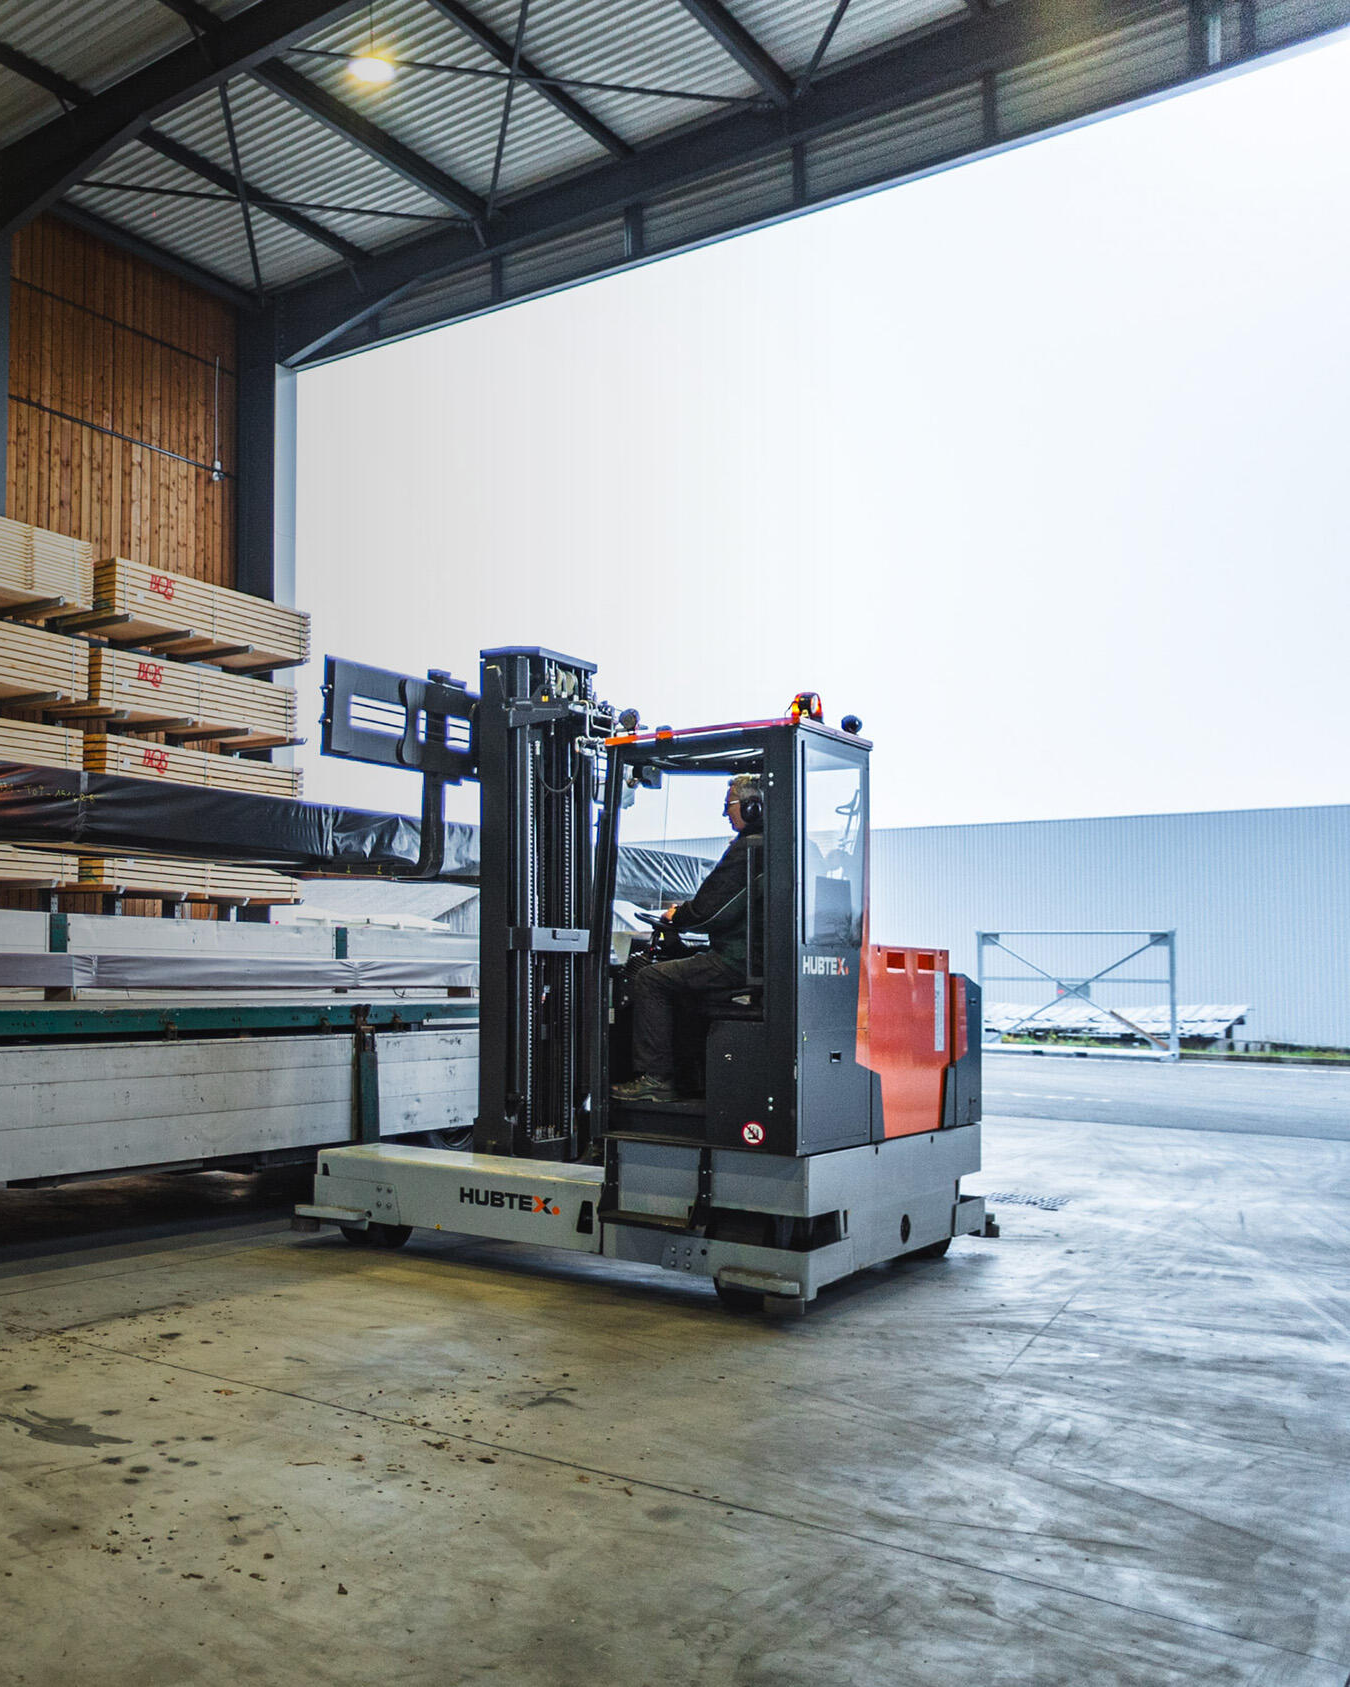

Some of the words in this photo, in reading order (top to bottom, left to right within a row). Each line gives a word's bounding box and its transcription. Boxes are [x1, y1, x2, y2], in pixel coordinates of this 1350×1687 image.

[150, 574, 176, 600] BQS
[138, 663, 164, 688] BQS
[143, 749, 170, 774] BQS
